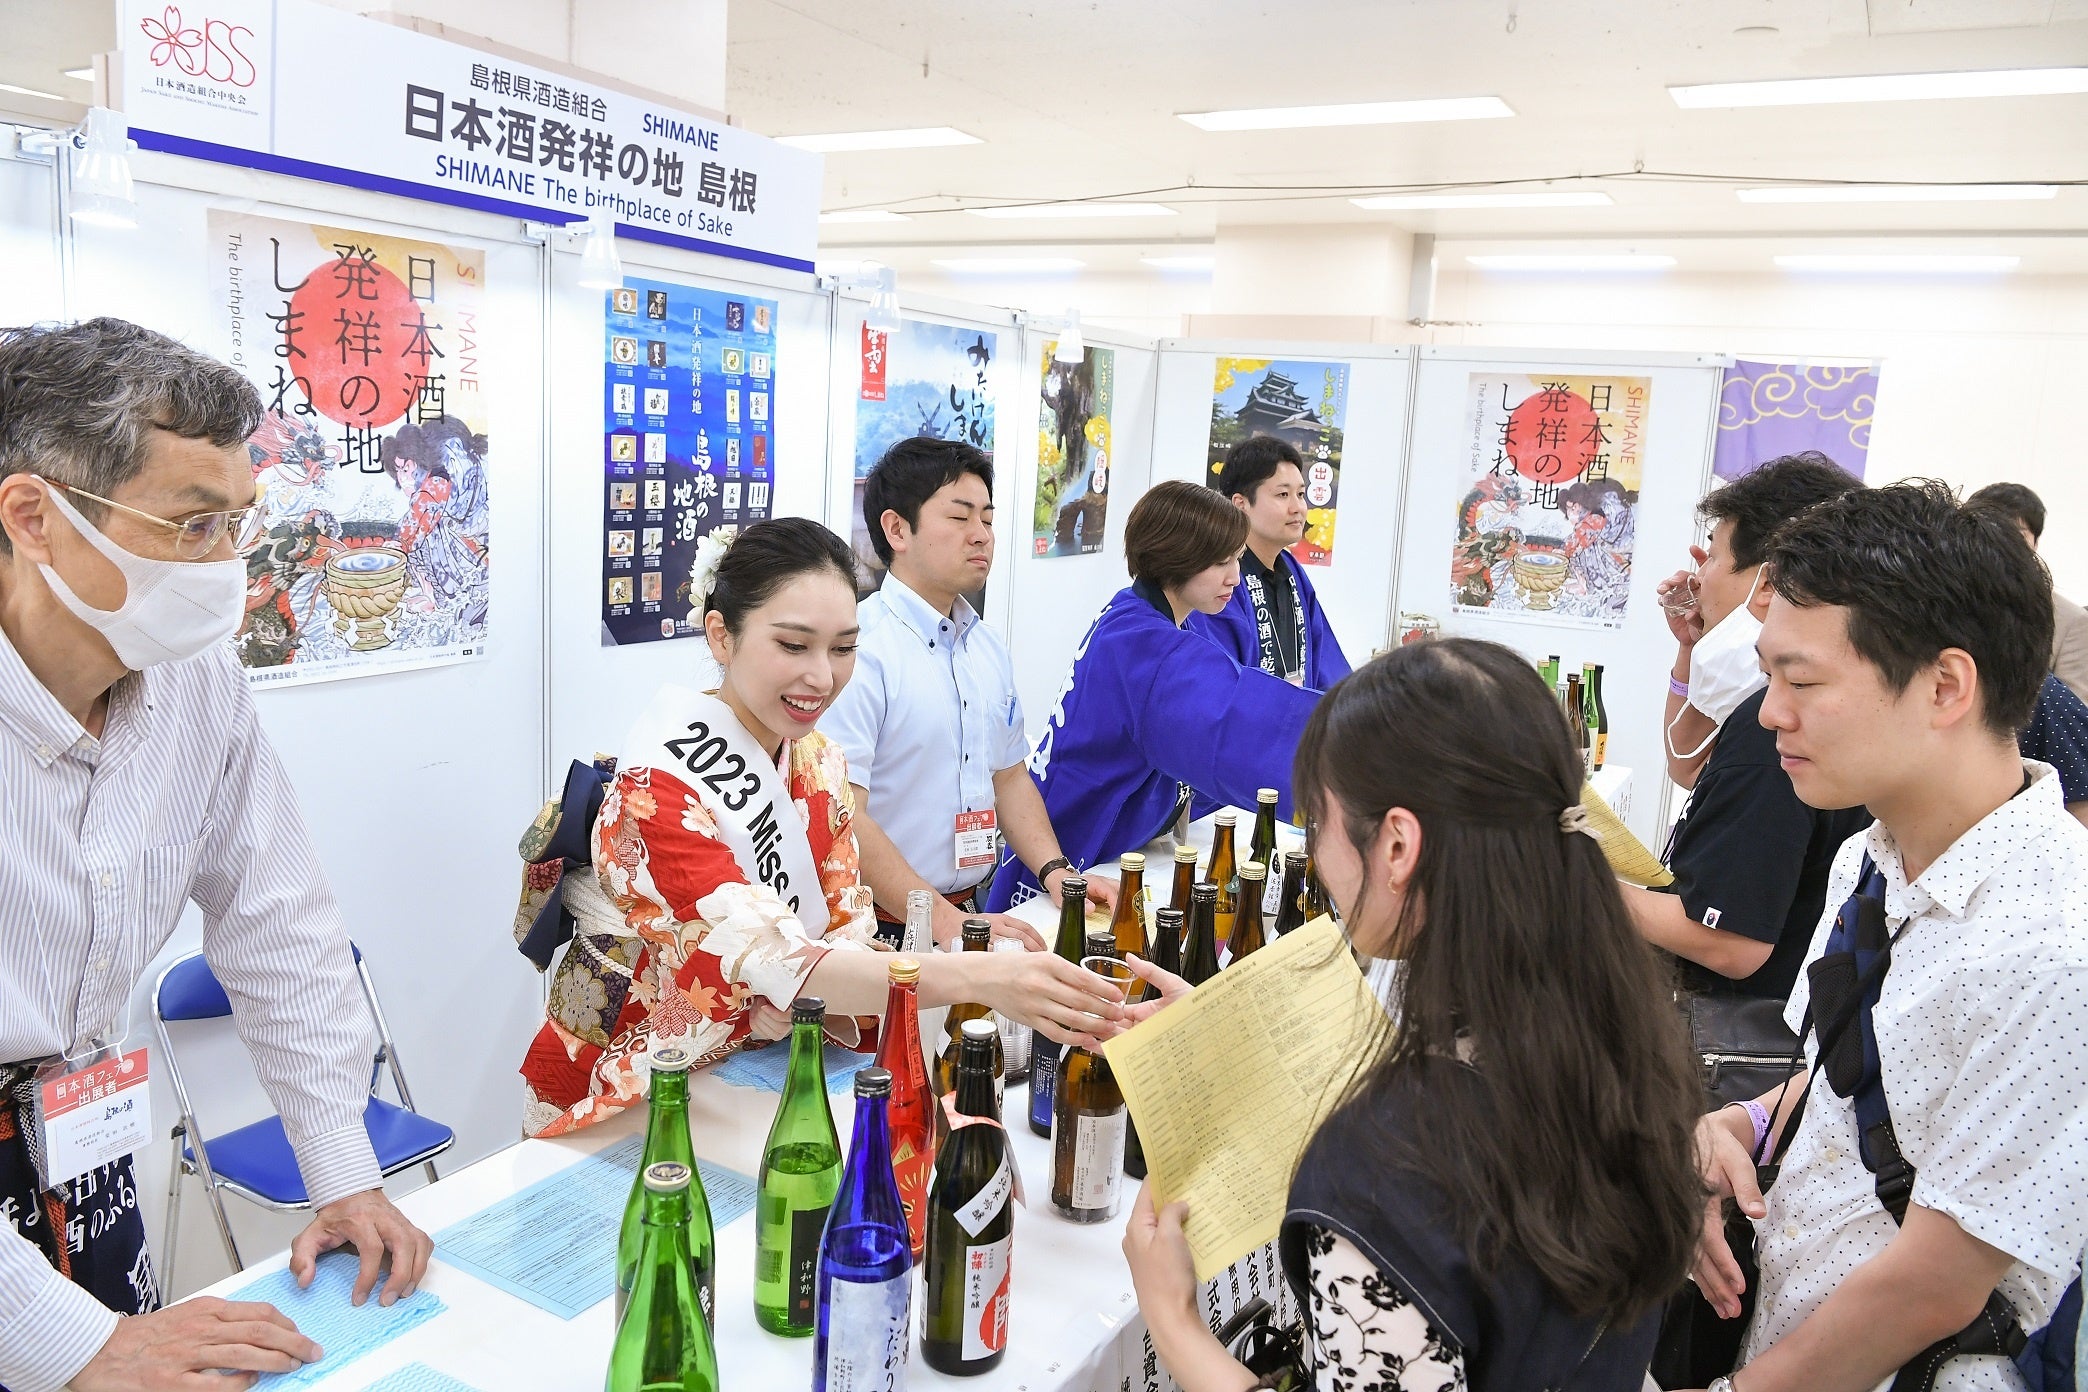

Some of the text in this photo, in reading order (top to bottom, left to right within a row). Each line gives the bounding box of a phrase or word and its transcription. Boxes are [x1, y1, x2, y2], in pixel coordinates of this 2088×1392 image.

[156, 77, 246, 105] 日本酒造組合中央会
[470, 63, 607, 122] 島根県酒造組合
[643, 112, 719, 152] SHIMANE
[405, 83, 757, 215] 日本酒発祥の地 島根
[435, 154, 733, 237] SHIMANE The birthplace of Sake
[228, 233, 248, 370] The birthplace of
[265, 237, 317, 419] しまね
[401, 255, 446, 425] 日本酒
[333, 243, 385, 474] 発祥の地
[691, 307, 704, 415] 日本酒発祥の地
[1319, 367, 1337, 442] しまねっこ
[950, 384, 968, 443] しま
[1489, 382, 1520, 479] しまね
[1529, 381, 1572, 511] 発祥の地
[1577, 384, 1613, 484] 日本酒
[1620, 386, 1644, 465] SHIMANE
[672, 478, 699, 542] 地酒
[691, 427, 719, 519] 島根の
[1245, 574, 1277, 677] 島根の酒で乾
[663, 721, 789, 896] 2023 Miss
[78, 1079, 117, 1107] 出展者
[800, 1260, 812, 1295] 津和野
